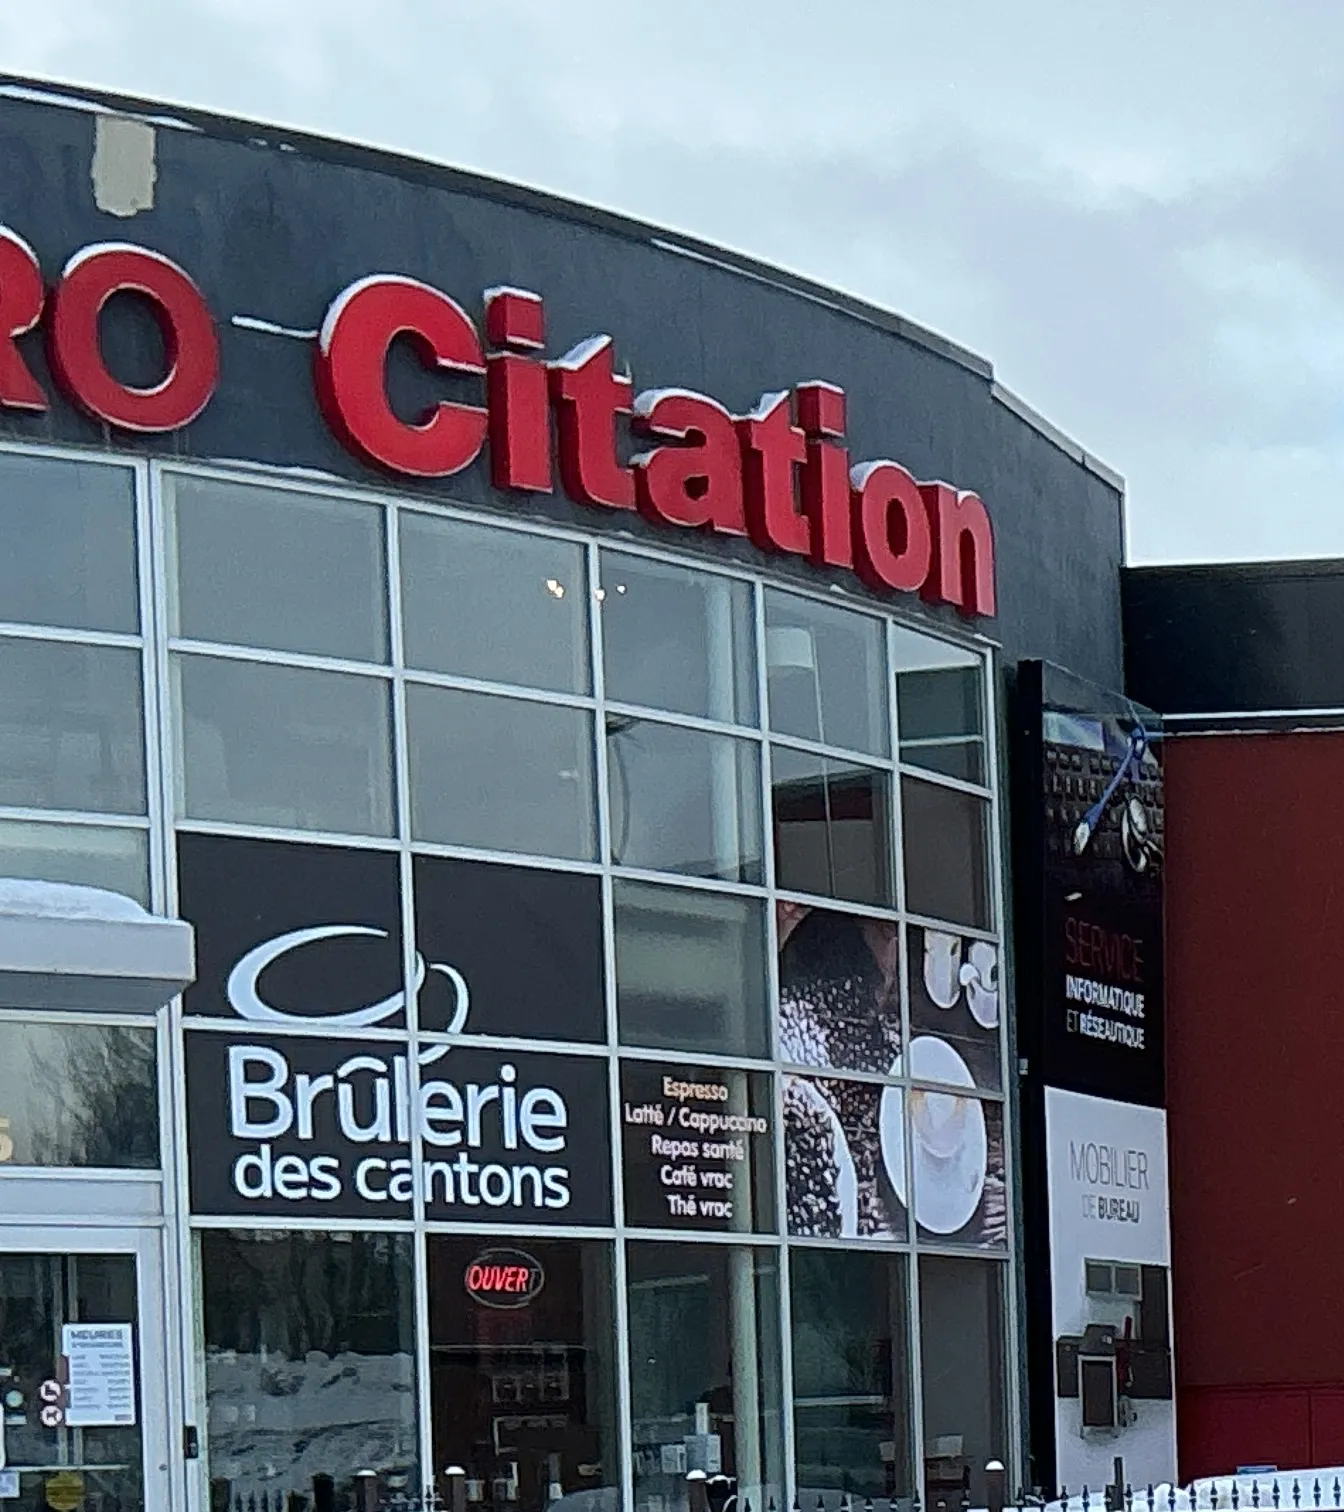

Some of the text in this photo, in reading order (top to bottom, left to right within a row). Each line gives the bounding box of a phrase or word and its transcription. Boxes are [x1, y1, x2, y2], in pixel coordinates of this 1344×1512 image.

[313, 273, 995, 617] Citation
[1065, 916, 1144, 983] SERVICE
[1066, 973, 1146, 1018] INFORMATIQUE
[1066, 1008, 1079, 1033] ET
[228, 1045, 568, 1152] Brûlerie
[662, 1075, 729, 1102] Espresso
[678, 1106, 768, 1134] Cappuccino
[651, 1134, 745, 1161] Repas santé
[234, 1144, 571, 1209] des cantons
[660, 1164, 734, 1189] Café vrac
[1069, 1140, 1150, 1191] MOBILIER
[666, 1194, 733, 1218] Thé vrac
[1081, 1193, 1140, 1224] DE BUREAU
[469, 1265, 541, 1293] OUVERT
